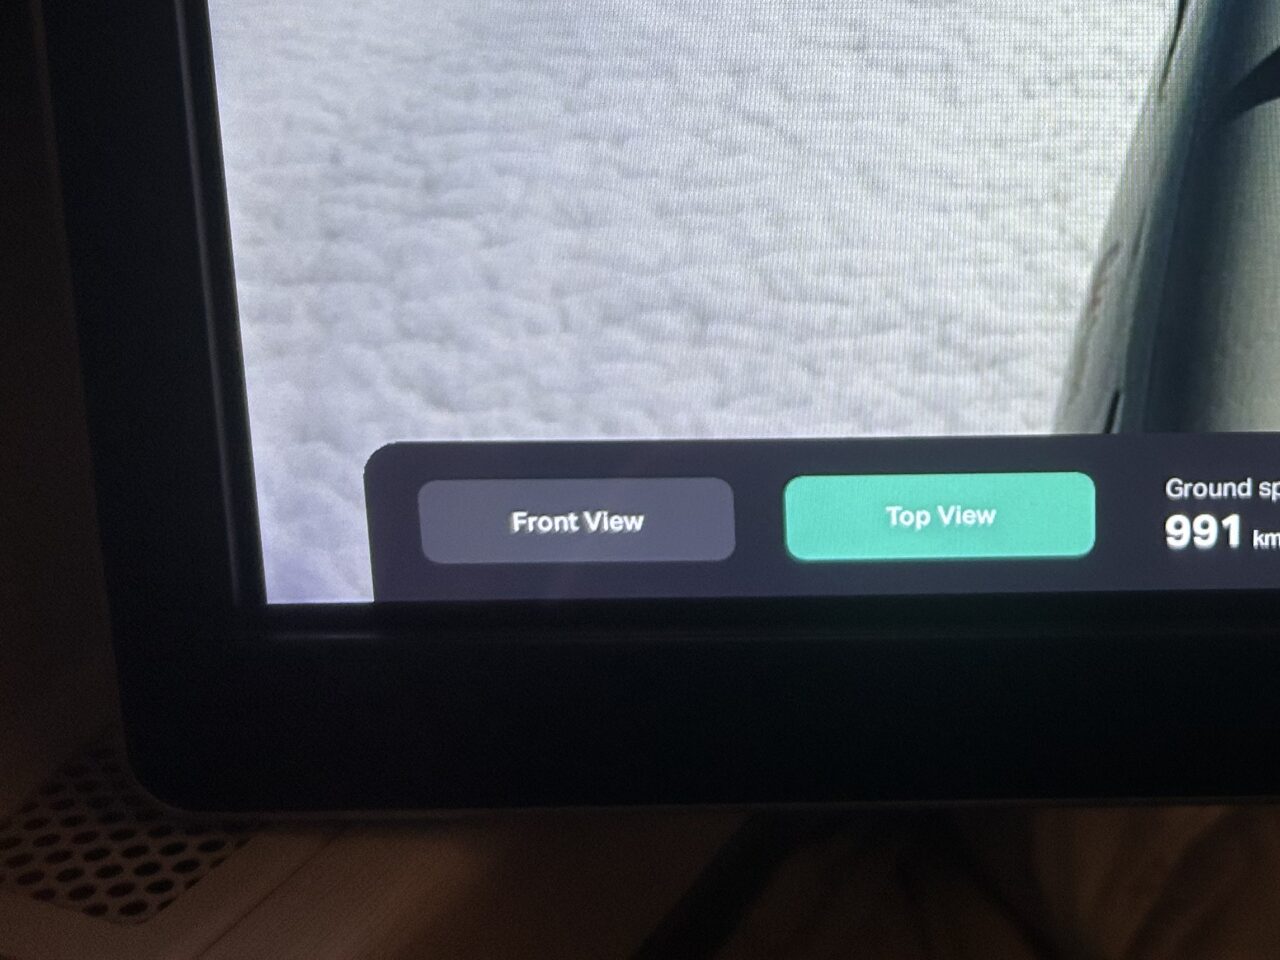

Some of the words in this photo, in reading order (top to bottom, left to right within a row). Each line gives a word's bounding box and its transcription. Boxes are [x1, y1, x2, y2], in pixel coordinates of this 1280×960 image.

[1165, 477, 1253, 499] Ground
[511, 511, 580, 533] Front
[582, 510, 645, 533] View
[885, 505, 931, 531] Top
[937, 505, 997, 527] View
[1165, 513, 1240, 550] 991
